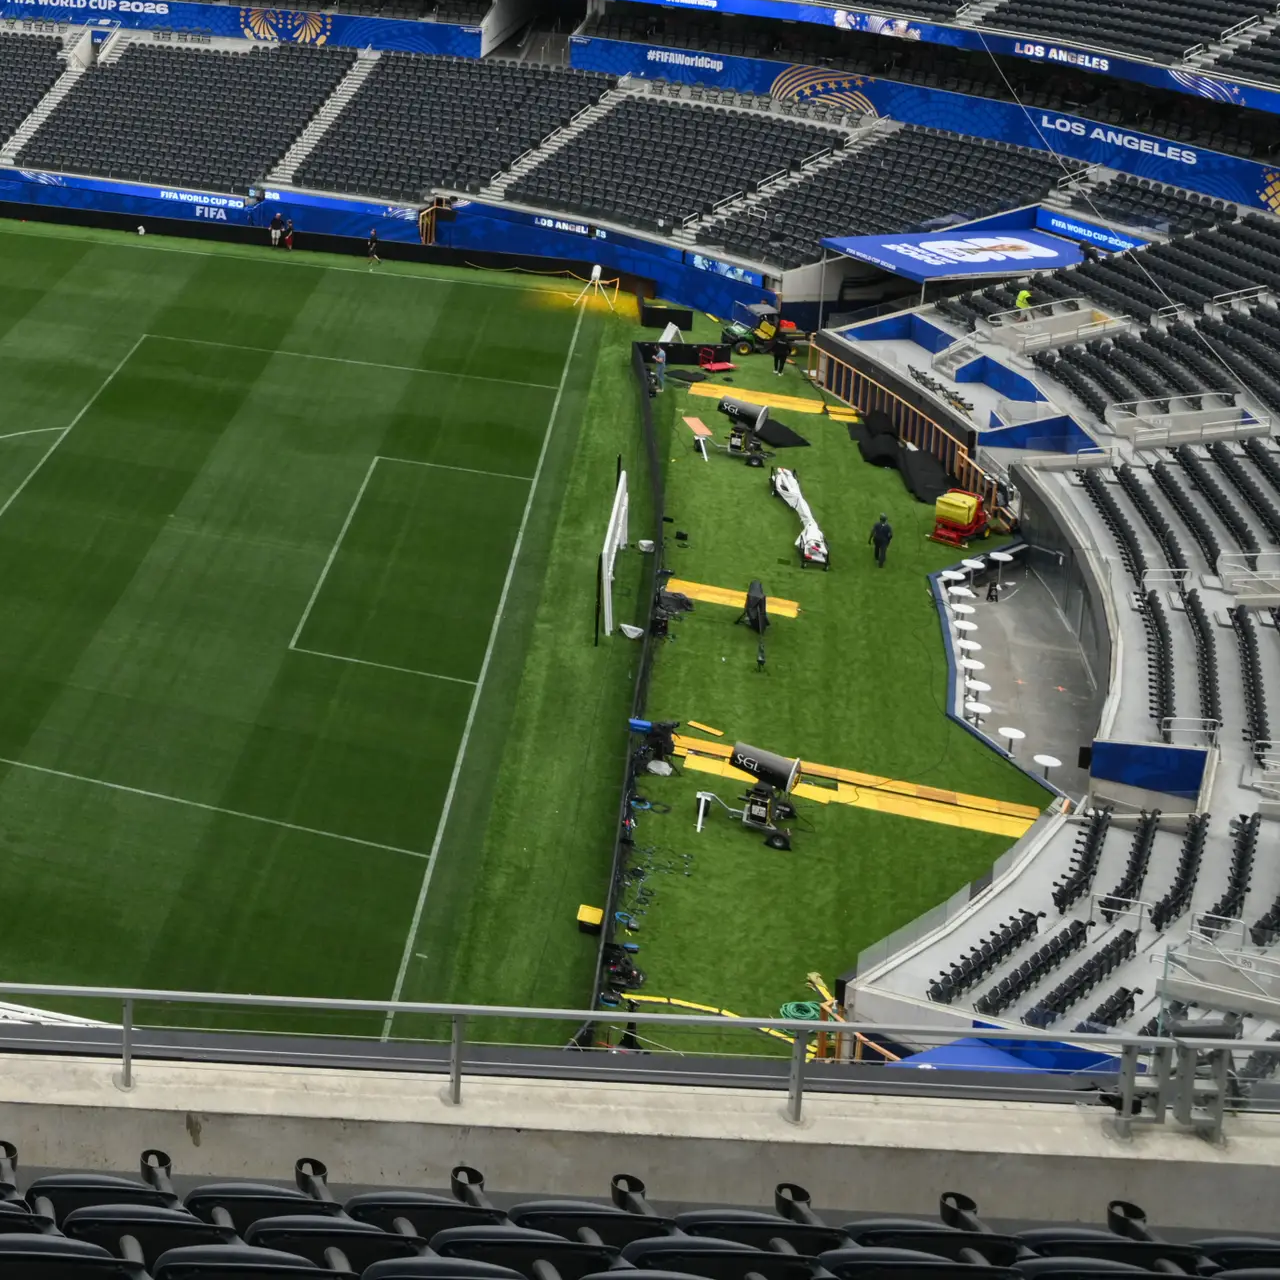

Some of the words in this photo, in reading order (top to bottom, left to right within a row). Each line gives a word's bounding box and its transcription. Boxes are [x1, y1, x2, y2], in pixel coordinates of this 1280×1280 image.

[118, 0, 170, 15] 2026
[646, 50, 724, 72] #FIFAWorldCup
[1014, 42, 1045, 57] LOS
[1048, 47, 1110, 71] ANGELES
[1041, 115, 1087, 136] LOS
[1090, 128, 1197, 165] ANGELES
[160, 190, 179, 200] FIFA
[179, 192, 209, 204] WORLD
[210, 195, 228, 206] CUP
[195, 205, 227, 221] FIFA
[534, 217, 554, 228] LOS
[1051, 218, 1067, 231] FIFA
[1067, 223, 1092, 238] WORLD
[1093, 230, 1108, 243] CUP
[722, 402, 740, 416] SGL
[734, 753, 760, 773] SGL
